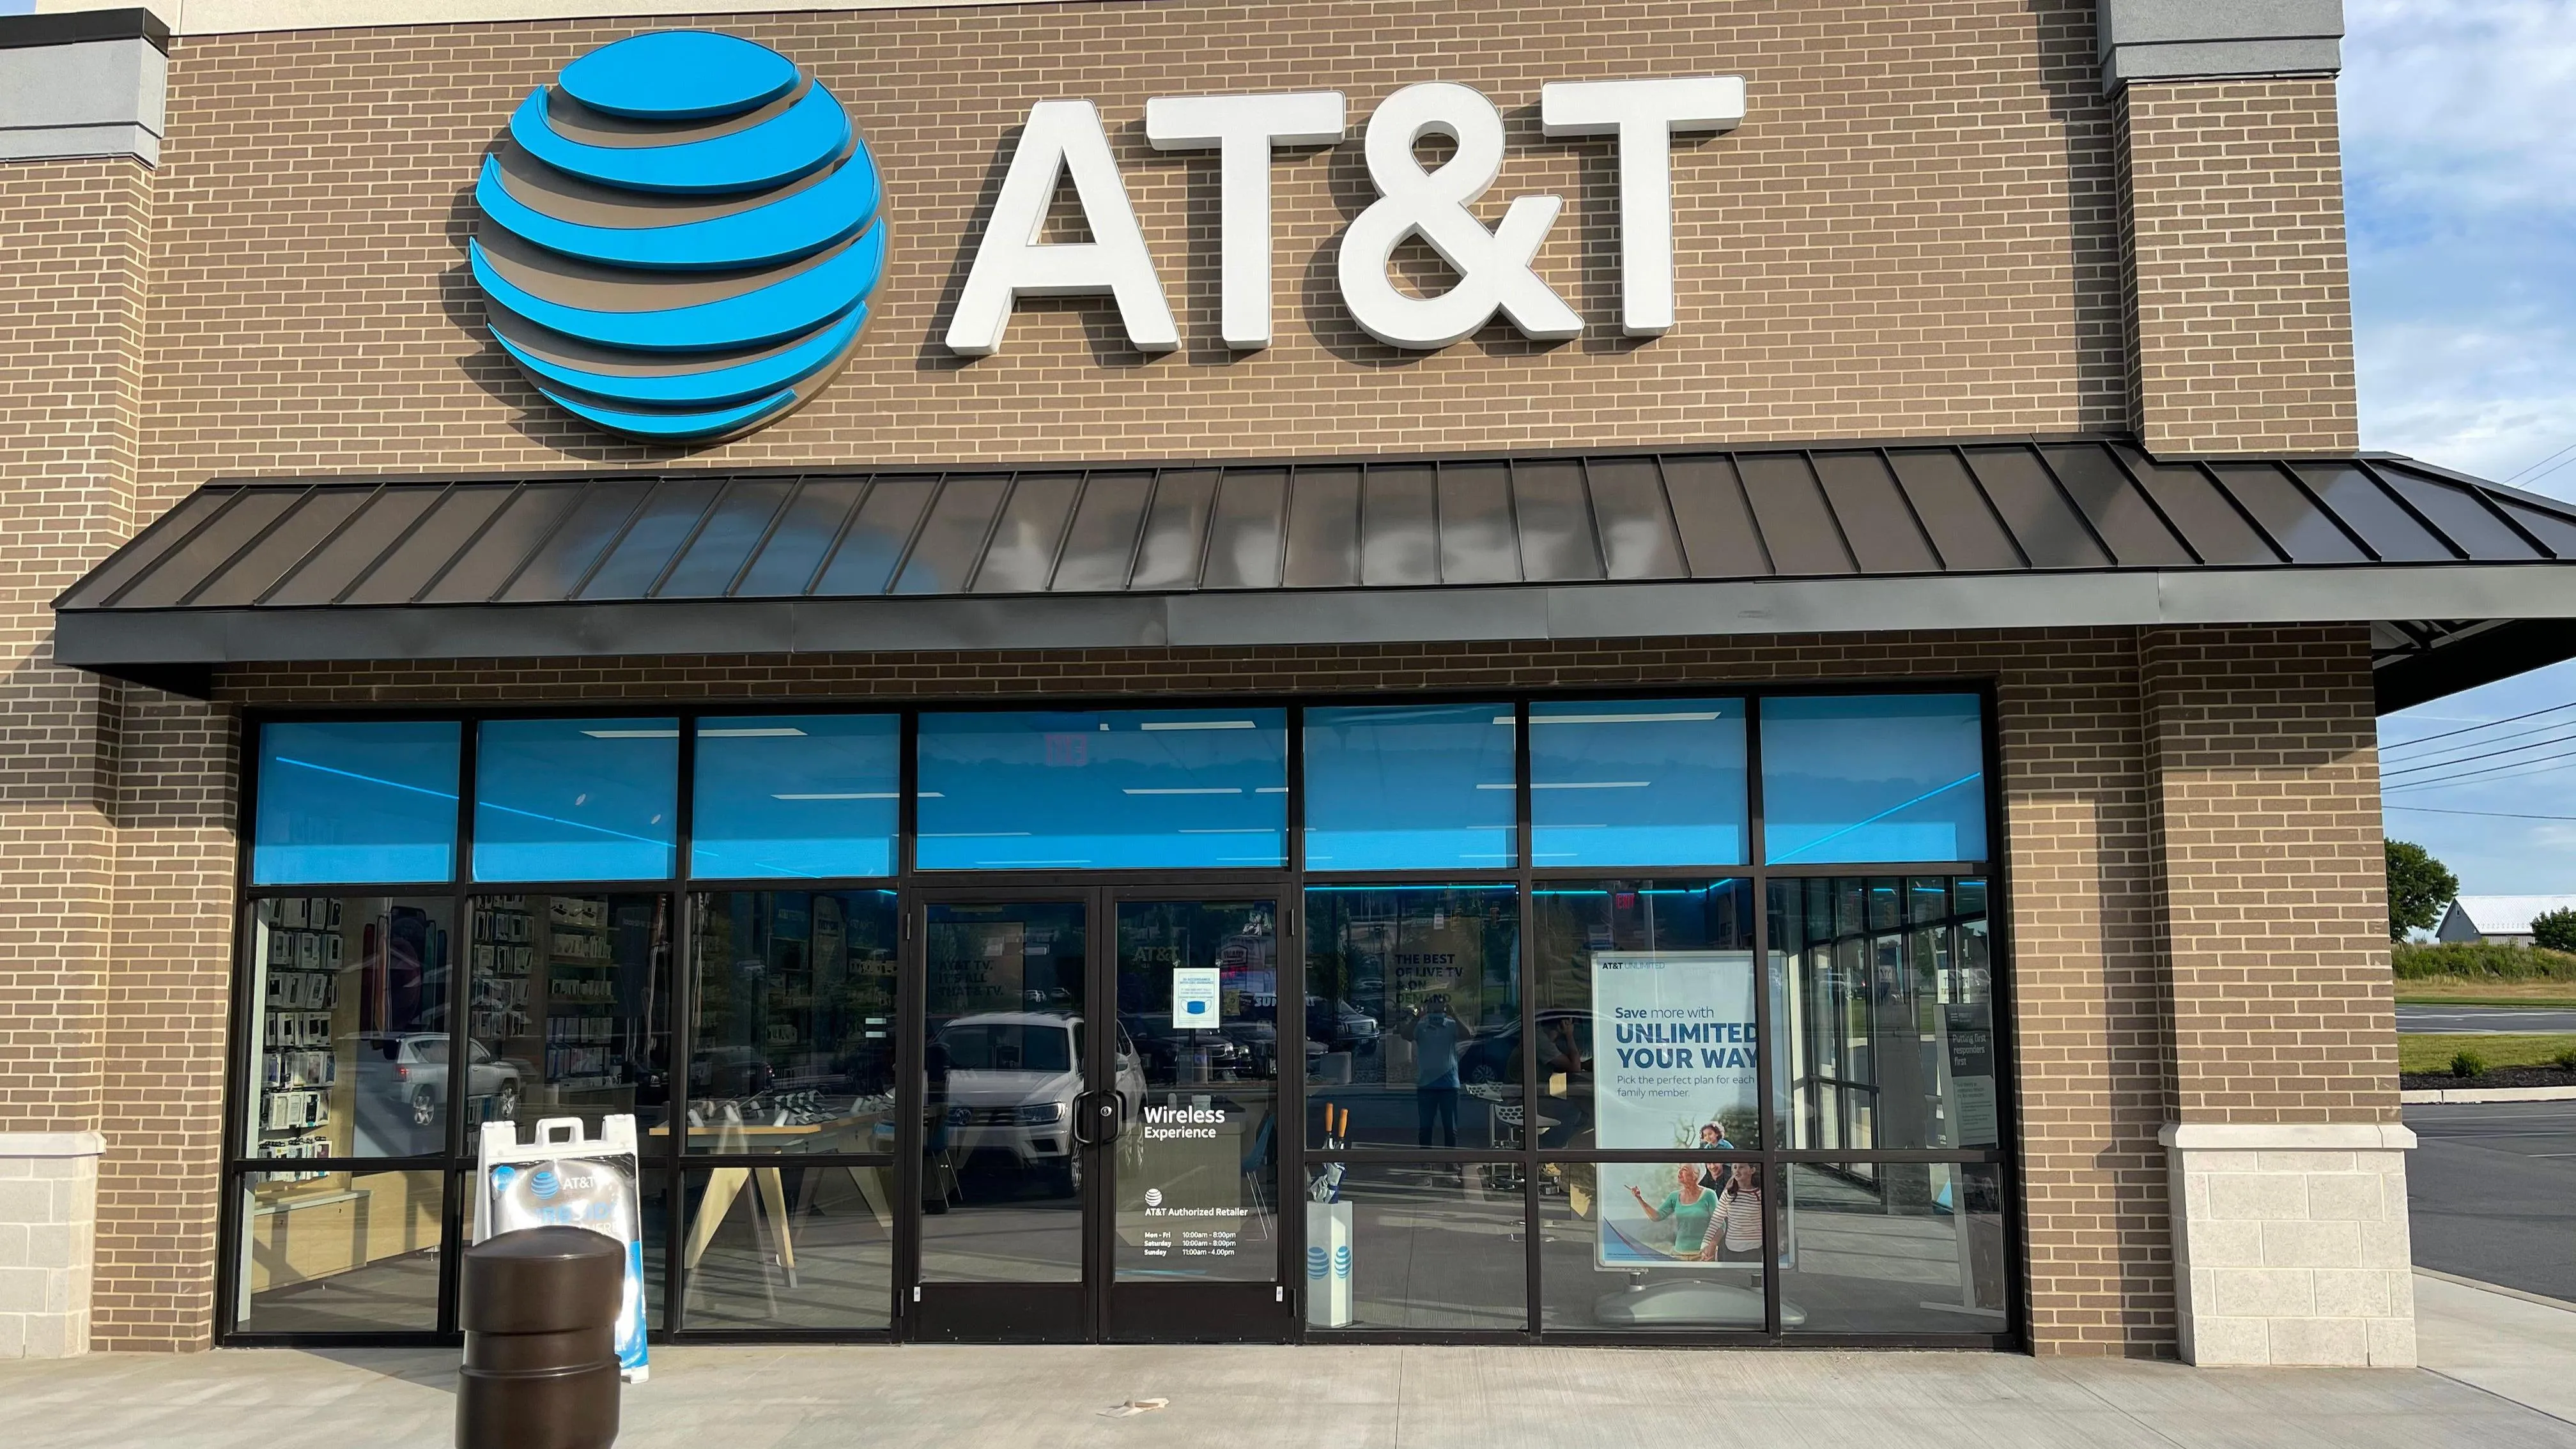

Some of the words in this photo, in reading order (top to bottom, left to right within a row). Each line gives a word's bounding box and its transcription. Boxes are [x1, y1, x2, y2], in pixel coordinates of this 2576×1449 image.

[945, 75, 1748, 356] AT&T
[1133, 946, 1180, 962] AT&T
[1395, 954, 1419, 964] THE
[1423, 954, 1455, 964] BEST
[1395, 967, 1412, 977] OF
[1415, 967, 1442, 977] LIVE
[1446, 967, 1463, 977] TV
[1408, 980, 1426, 990] ON
[1396, 993, 1451, 1004] DEMAND
[1616, 1007, 1647, 1018] Save
[1651, 1009, 1684, 1018] more
[1687, 1006, 1714, 1018] with
[1616, 1023, 1757, 1043] UNLIMITED
[1952, 1034, 1973, 1045] Putting
[1974, 1033, 1986, 1043] first
[1954, 1045, 1985, 1055] responders
[1616, 1048, 1693, 1069] YOUR
[1701, 1048, 1757, 1068] WAY
[1954, 1057, 1966, 1066] first
[1617, 1075, 1636, 1084] Pick
[1638, 1075, 1654, 1084] the
[1656, 1075, 1691, 1086] perfect
[1694, 1075, 1713, 1086] plan
[1716, 1075, 1729, 1084] for
[1732, 1075, 1755, 1084] each
[1617, 1088, 1646, 1100] family
[1648, 1088, 1690, 1097] member.
[1144, 1105, 1225, 1124] Wireless
[1144, 1126, 1216, 1142] Experience
[562, 1176, 595, 1190] AT&T
[1145, 1208, 1167, 1216] AT&T
[1168, 1208, 1214, 1216] Authorized
[1215, 1208, 1248, 1216] Retailer
